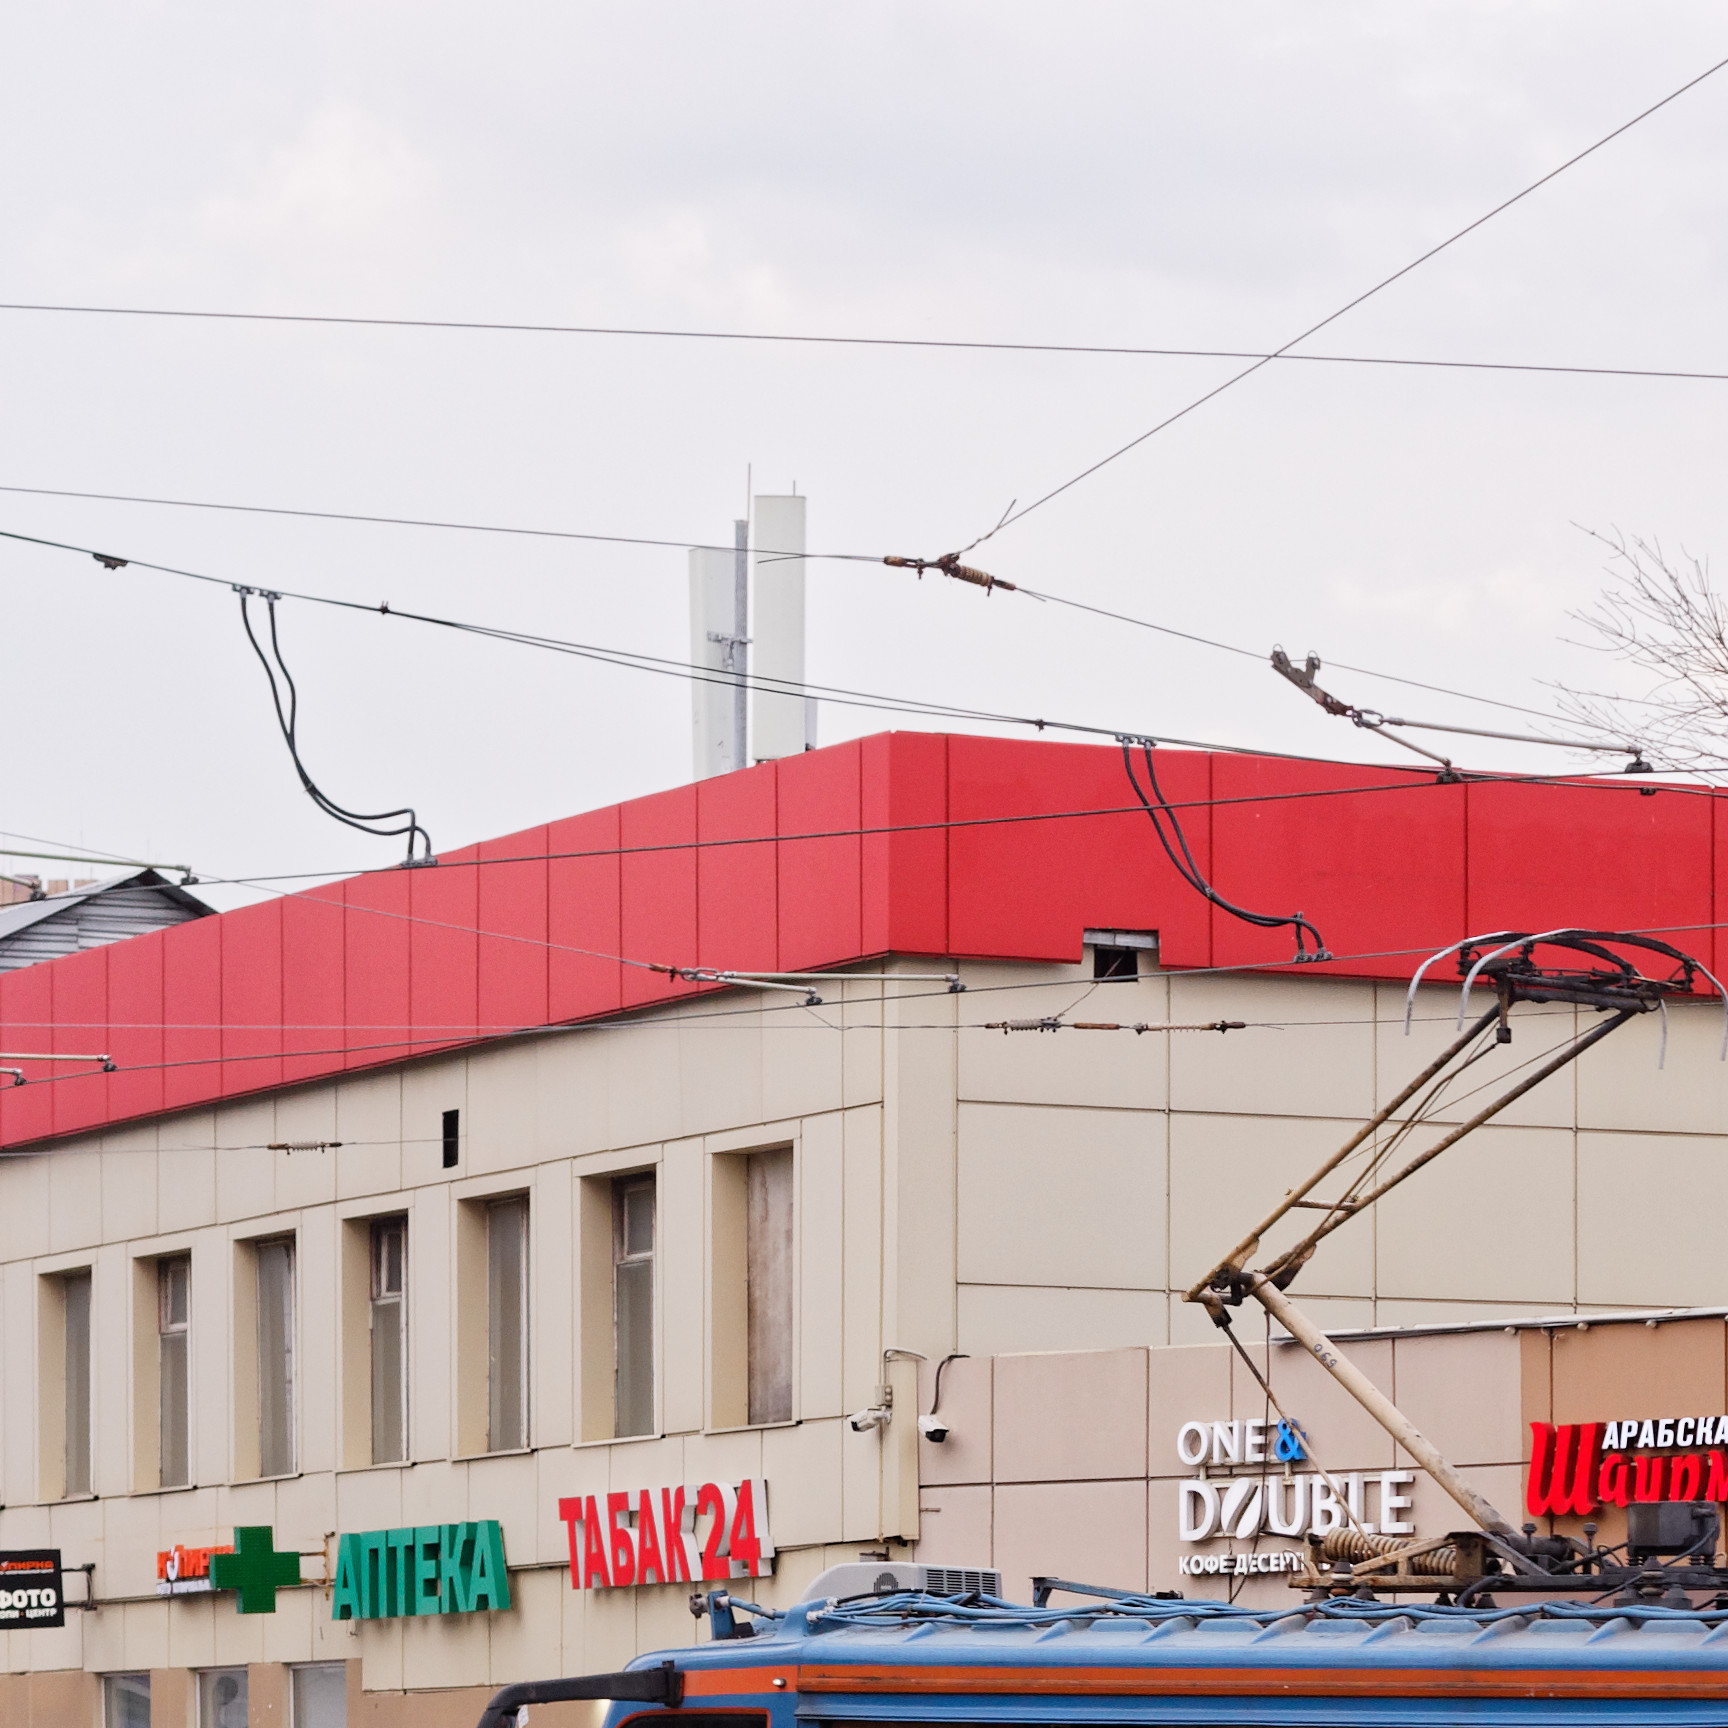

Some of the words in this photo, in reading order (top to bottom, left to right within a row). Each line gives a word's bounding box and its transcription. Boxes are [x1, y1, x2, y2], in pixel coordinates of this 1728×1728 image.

[1177, 1419, 1267, 1466] ONE
[1274, 1417, 1308, 1463] &
[332, 1520, 510, 1621] АПТЕКА
[559, 1486, 700, 1590] ТАБАК
[696, 1479, 768, 1581] 24
[1178, 1554, 1229, 1575] КОФЕ
